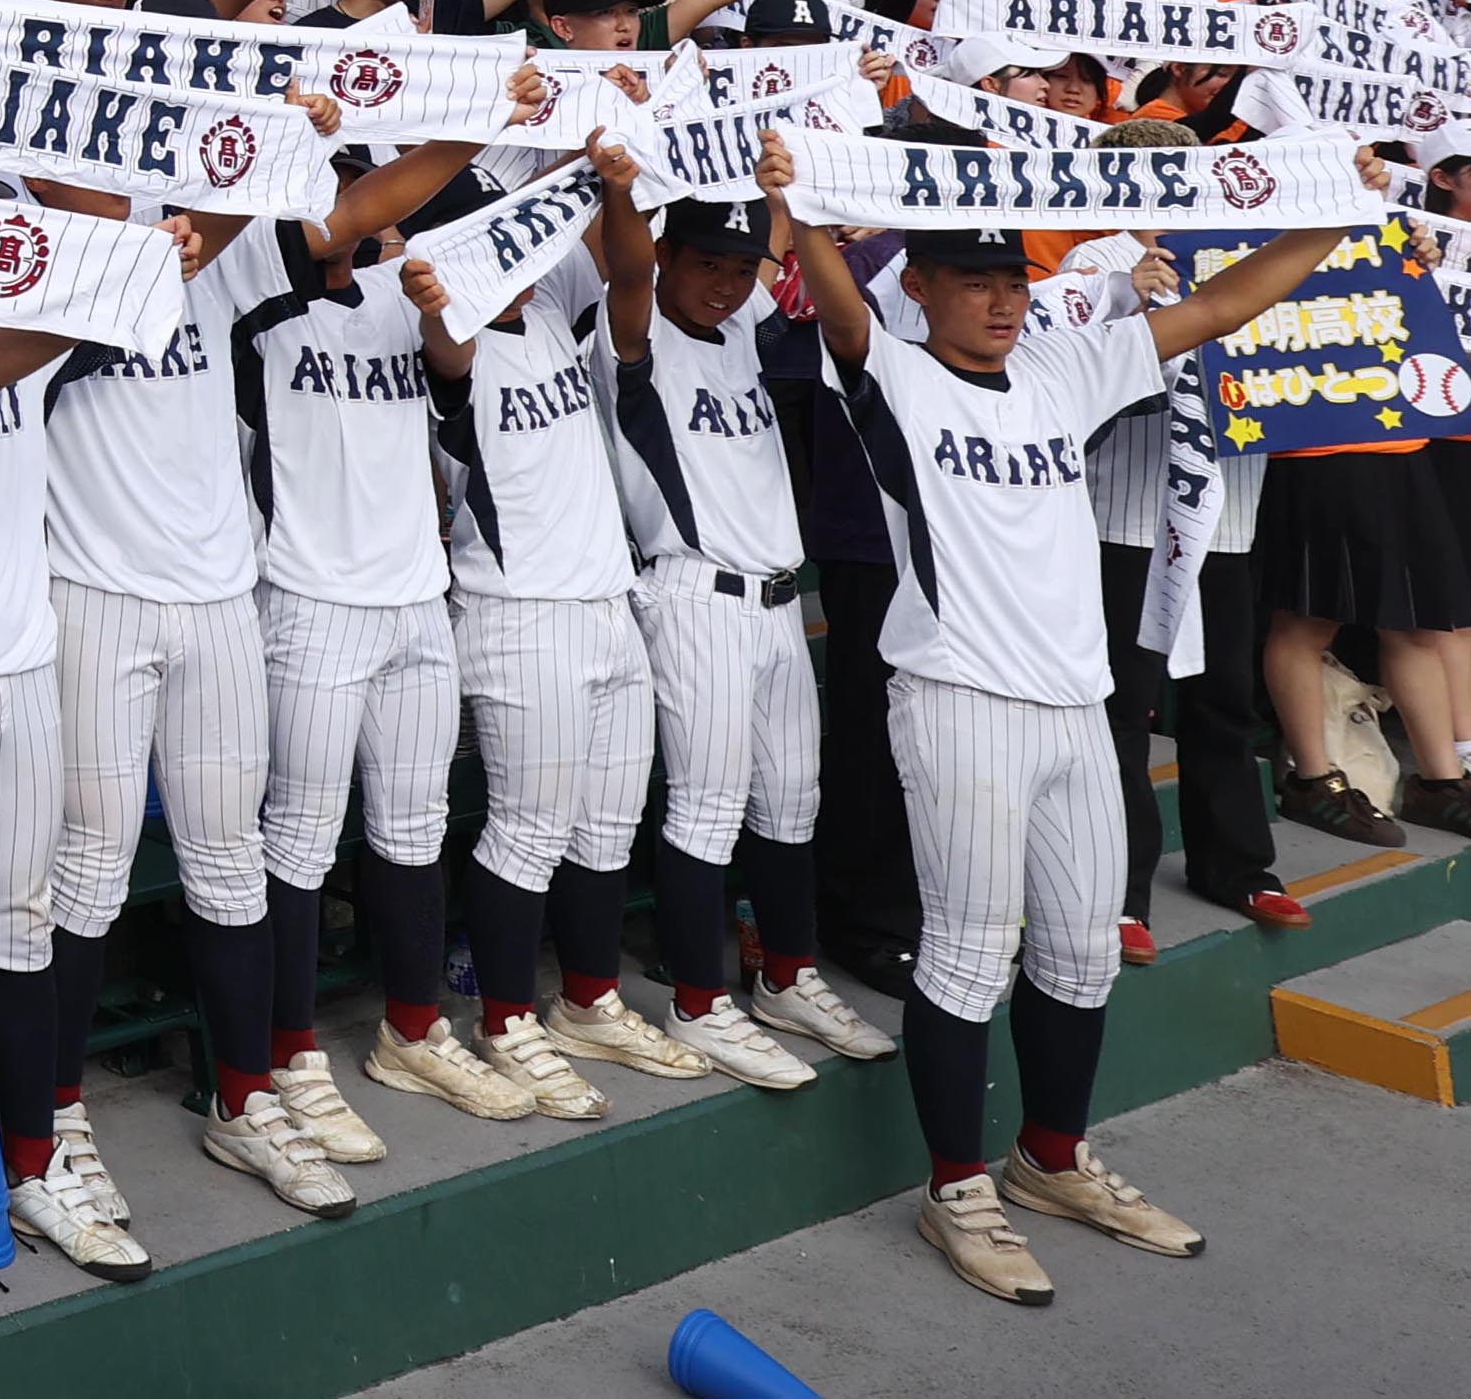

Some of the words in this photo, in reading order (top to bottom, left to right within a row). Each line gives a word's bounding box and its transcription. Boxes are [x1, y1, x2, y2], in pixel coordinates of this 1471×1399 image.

[793, 0, 814, 24] A
[1293, 74, 1403, 125] RIAKE
[663, 123, 758, 183] ARIA
[903, 148, 1198, 209] ARIAKE
[470, 168, 501, 192] A
[724, 203, 751, 234] A
[1221, 291, 1410, 356] 有明高校
[291, 345, 427, 400] ARIAK
[1219, 364, 1399, 410] 心はひとつ
[935, 428, 1082, 488] ARIAK
